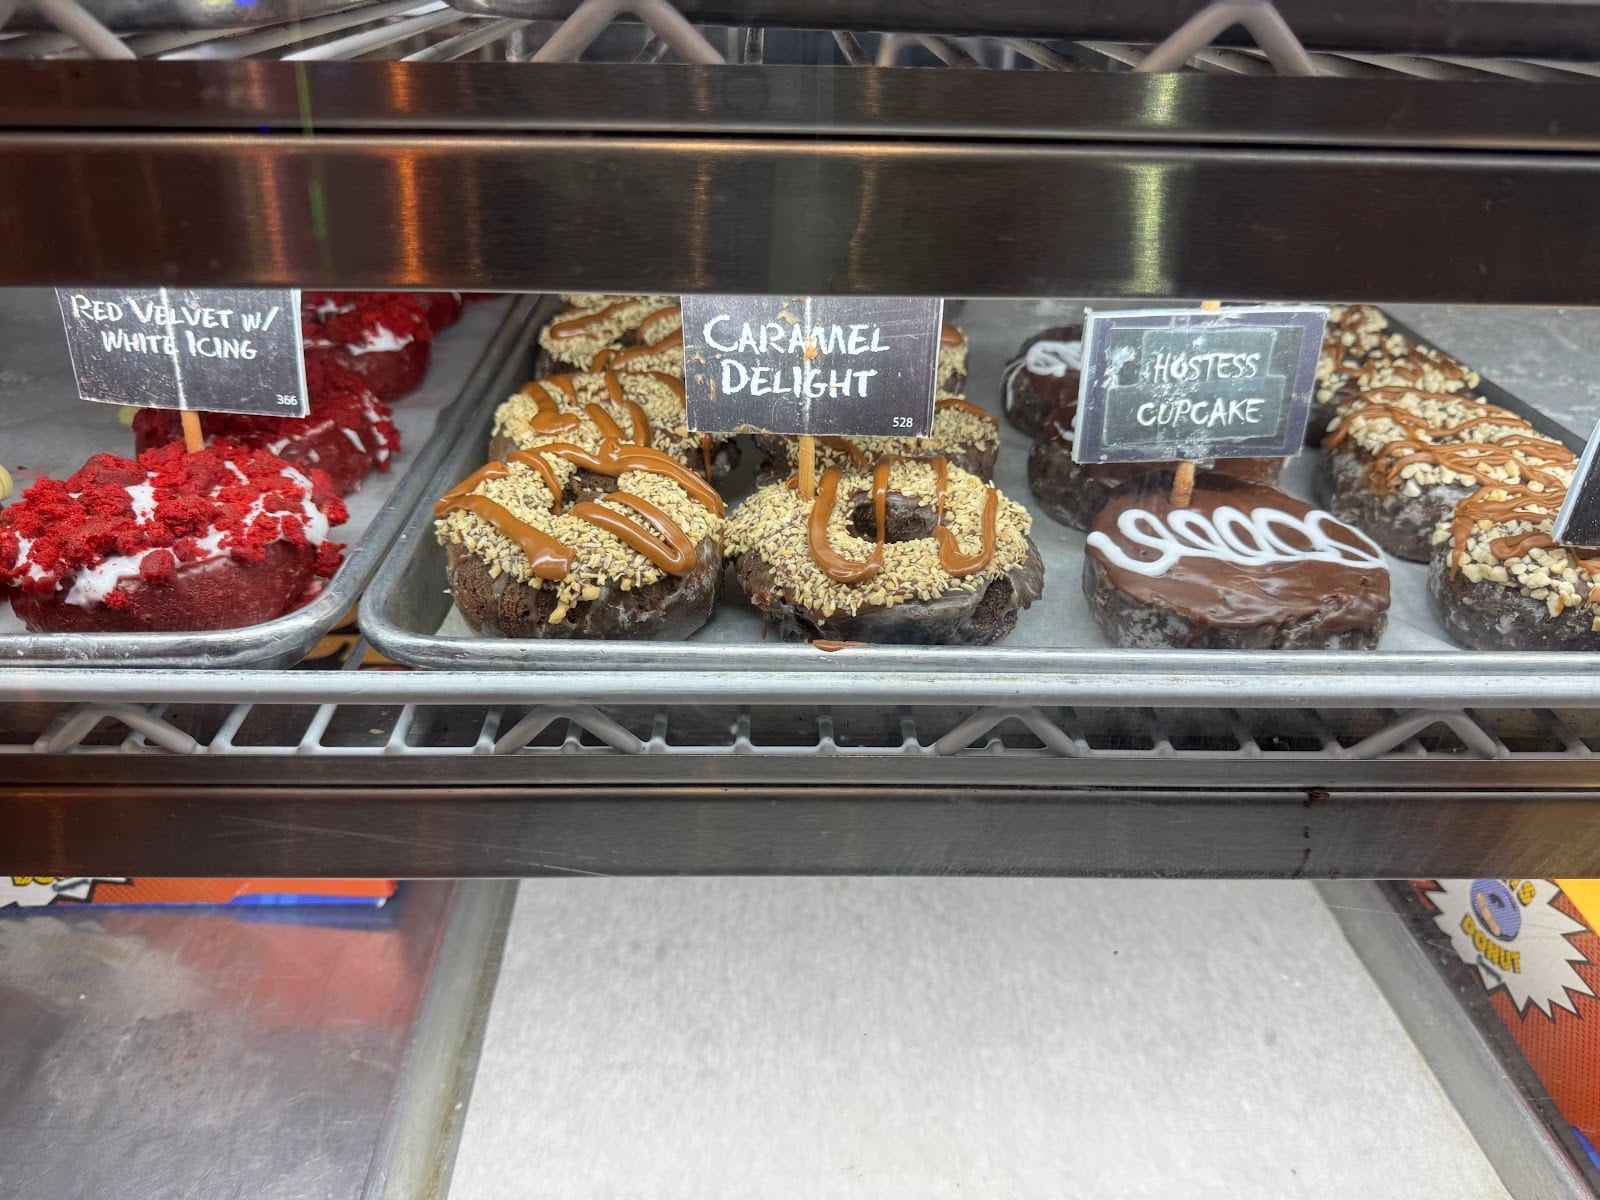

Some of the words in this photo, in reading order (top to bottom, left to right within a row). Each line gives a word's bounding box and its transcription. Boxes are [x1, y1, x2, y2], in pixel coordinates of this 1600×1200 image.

[71, 294, 123, 322] RED
[126, 299, 234, 329] VELVET
[101, 329, 179, 355] WHITE
[185, 330, 258, 360] ICING
[703, 314, 890, 355] CARAMEL
[721, 358, 878, 399] DELIGHT
[1154, 352, 1261, 384] HOSTESS
[276, 394, 299, 406] 366
[1136, 399, 1266, 428] CUPCAKE
[892, 417, 914, 428] 528
[1460, 912, 1522, 974] DONUT
